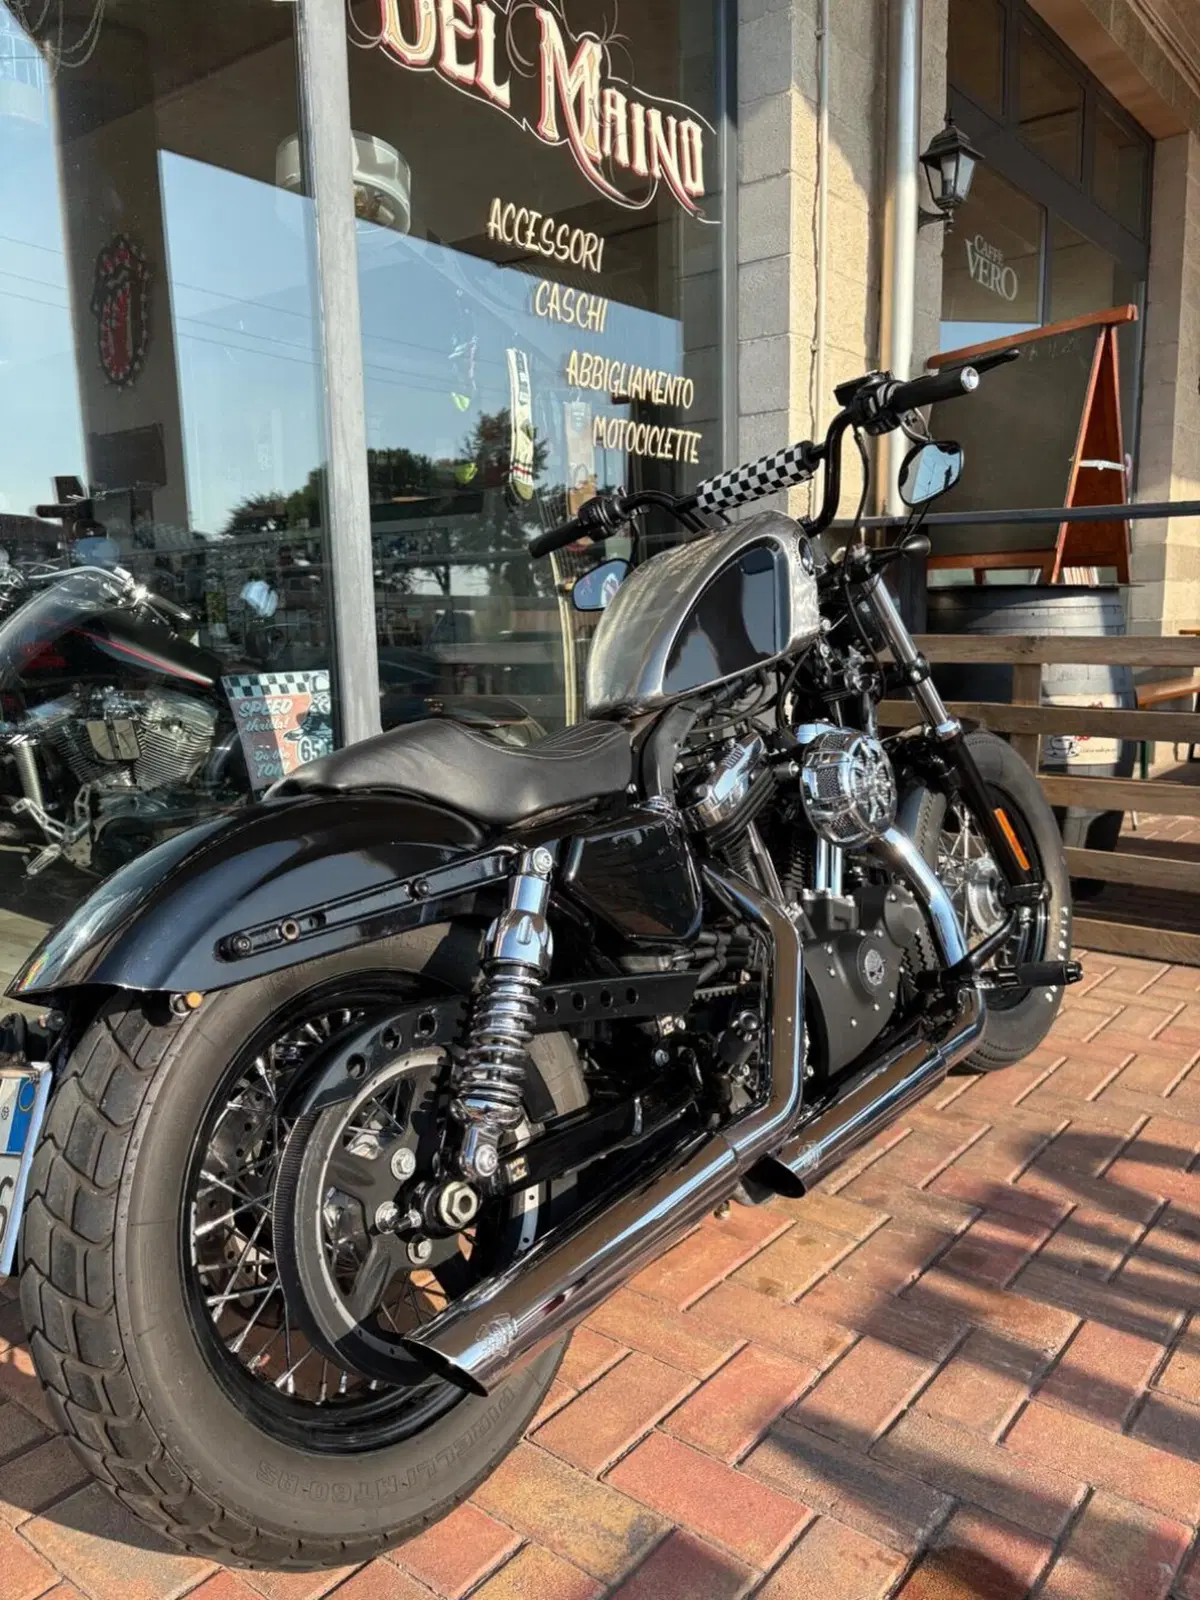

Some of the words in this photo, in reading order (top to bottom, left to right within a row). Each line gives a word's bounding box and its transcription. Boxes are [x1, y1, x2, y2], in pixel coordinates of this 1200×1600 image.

[535, 5, 706, 208] MAINO
[487, 197, 604, 273] ACCESSORI
[964, 238, 1018, 301] VERO
[535, 280, 608, 333] CASCHI
[566, 349, 694, 410] ABBIGLIAMENTO
[592, 415, 702, 464] MOTOCICLETTE
[239, 698, 293, 717] SPEED
[301, 740, 320, 760] 65
[405, 1384, 516, 1488] PIRELLI
